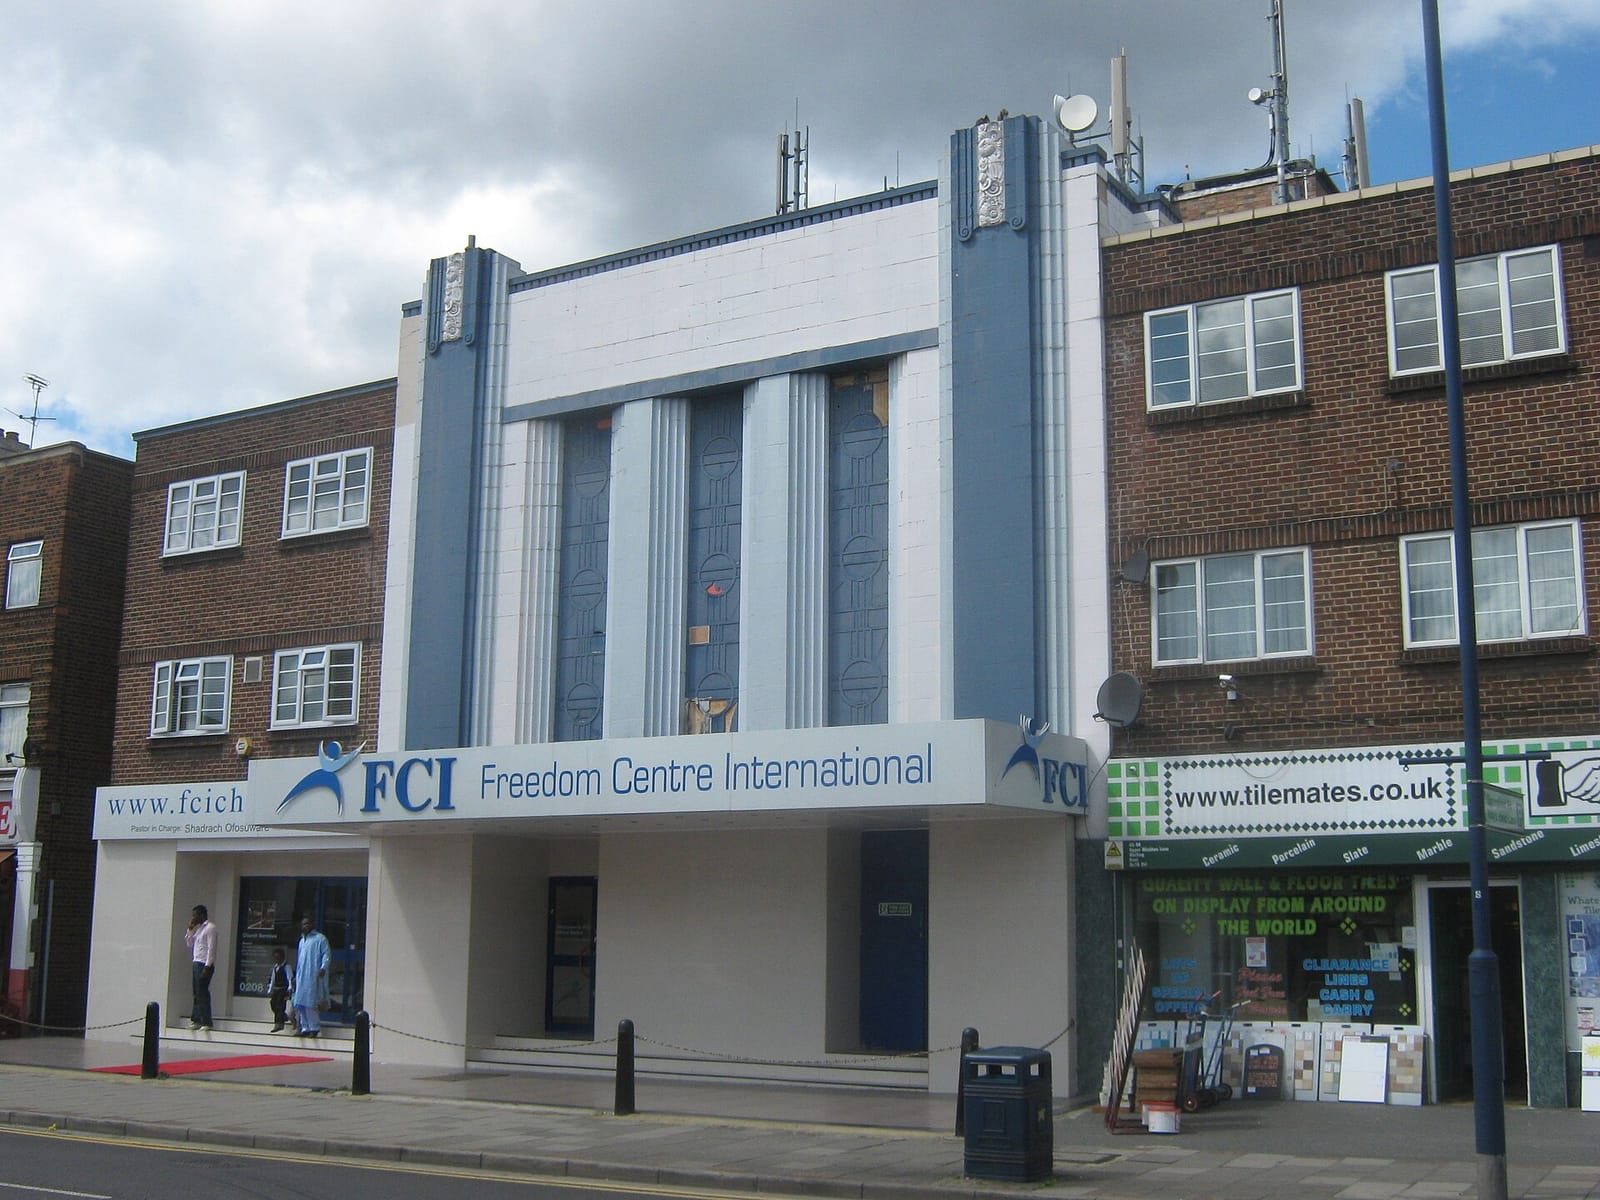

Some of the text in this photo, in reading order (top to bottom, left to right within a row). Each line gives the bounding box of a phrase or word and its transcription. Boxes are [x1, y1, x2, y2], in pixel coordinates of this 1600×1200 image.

[360, 742, 932, 813] FCI Freedom Centre International
[1042, 758, 1088, 808] FCI
[109, 787, 243, 816] www.fcich
[1175, 777, 1443, 808] www.tilemates.co.uk
[130, 825, 151, 833] Pastor
[184, 824, 223, 833] Shadrach
[1271, 838, 1316, 865] Porcelain
[1415, 837, 1454, 861] Marble
[1490, 830, 1545, 859] Sandstone
[1202, 843, 1240, 868] Ceramic
[1342, 845, 1369, 864] Slate
[1142, 879, 1213, 892] QUALITY
[1219, 878, 1263, 891] WALL
[1269, 878, 1281, 890] &
[1287, 876, 1344, 890] FLOOR
[1153, 896, 1386, 914] ON DISPLAY FROM AROUND
[1217, 919, 1317, 936] THE WORLD
[1303, 959, 1390, 971] CLEARANCE
[1324, 974, 1369, 986] LINES
[1319, 989, 1375, 1001] CASH &
[1322, 1004, 1373, 1016] CARRY
